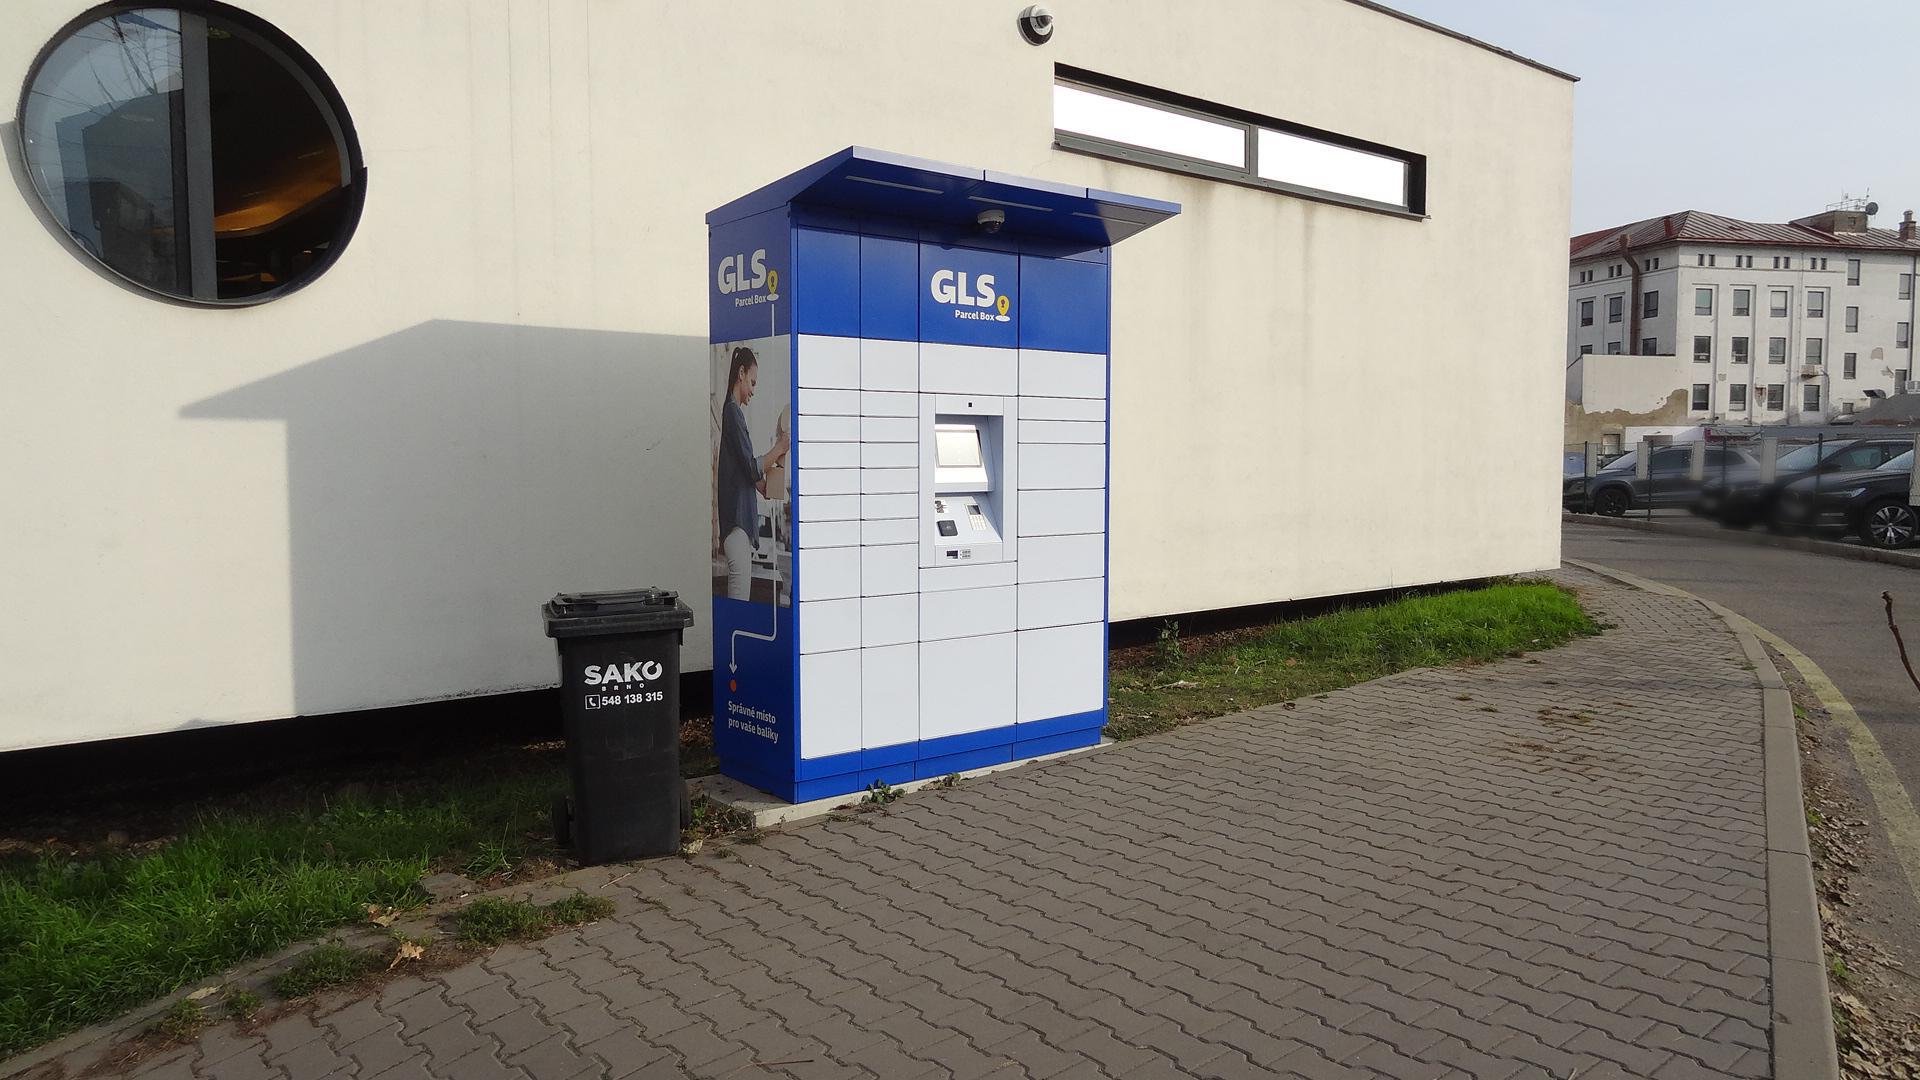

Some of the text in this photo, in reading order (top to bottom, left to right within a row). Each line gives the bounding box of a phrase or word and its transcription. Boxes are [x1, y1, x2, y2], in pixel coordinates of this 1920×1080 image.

[718, 248, 767, 295] GLS
[735, 294, 767, 307] Parcel Box
[931, 269, 996, 308] GLS
[955, 309, 995, 321] Parcel Box
[584, 660, 663, 685] SAKO
[601, 691, 663, 706] 548 138 315
[728, 700, 776, 724] Správné místo
[728, 718, 779, 744] pro vaše balíky
